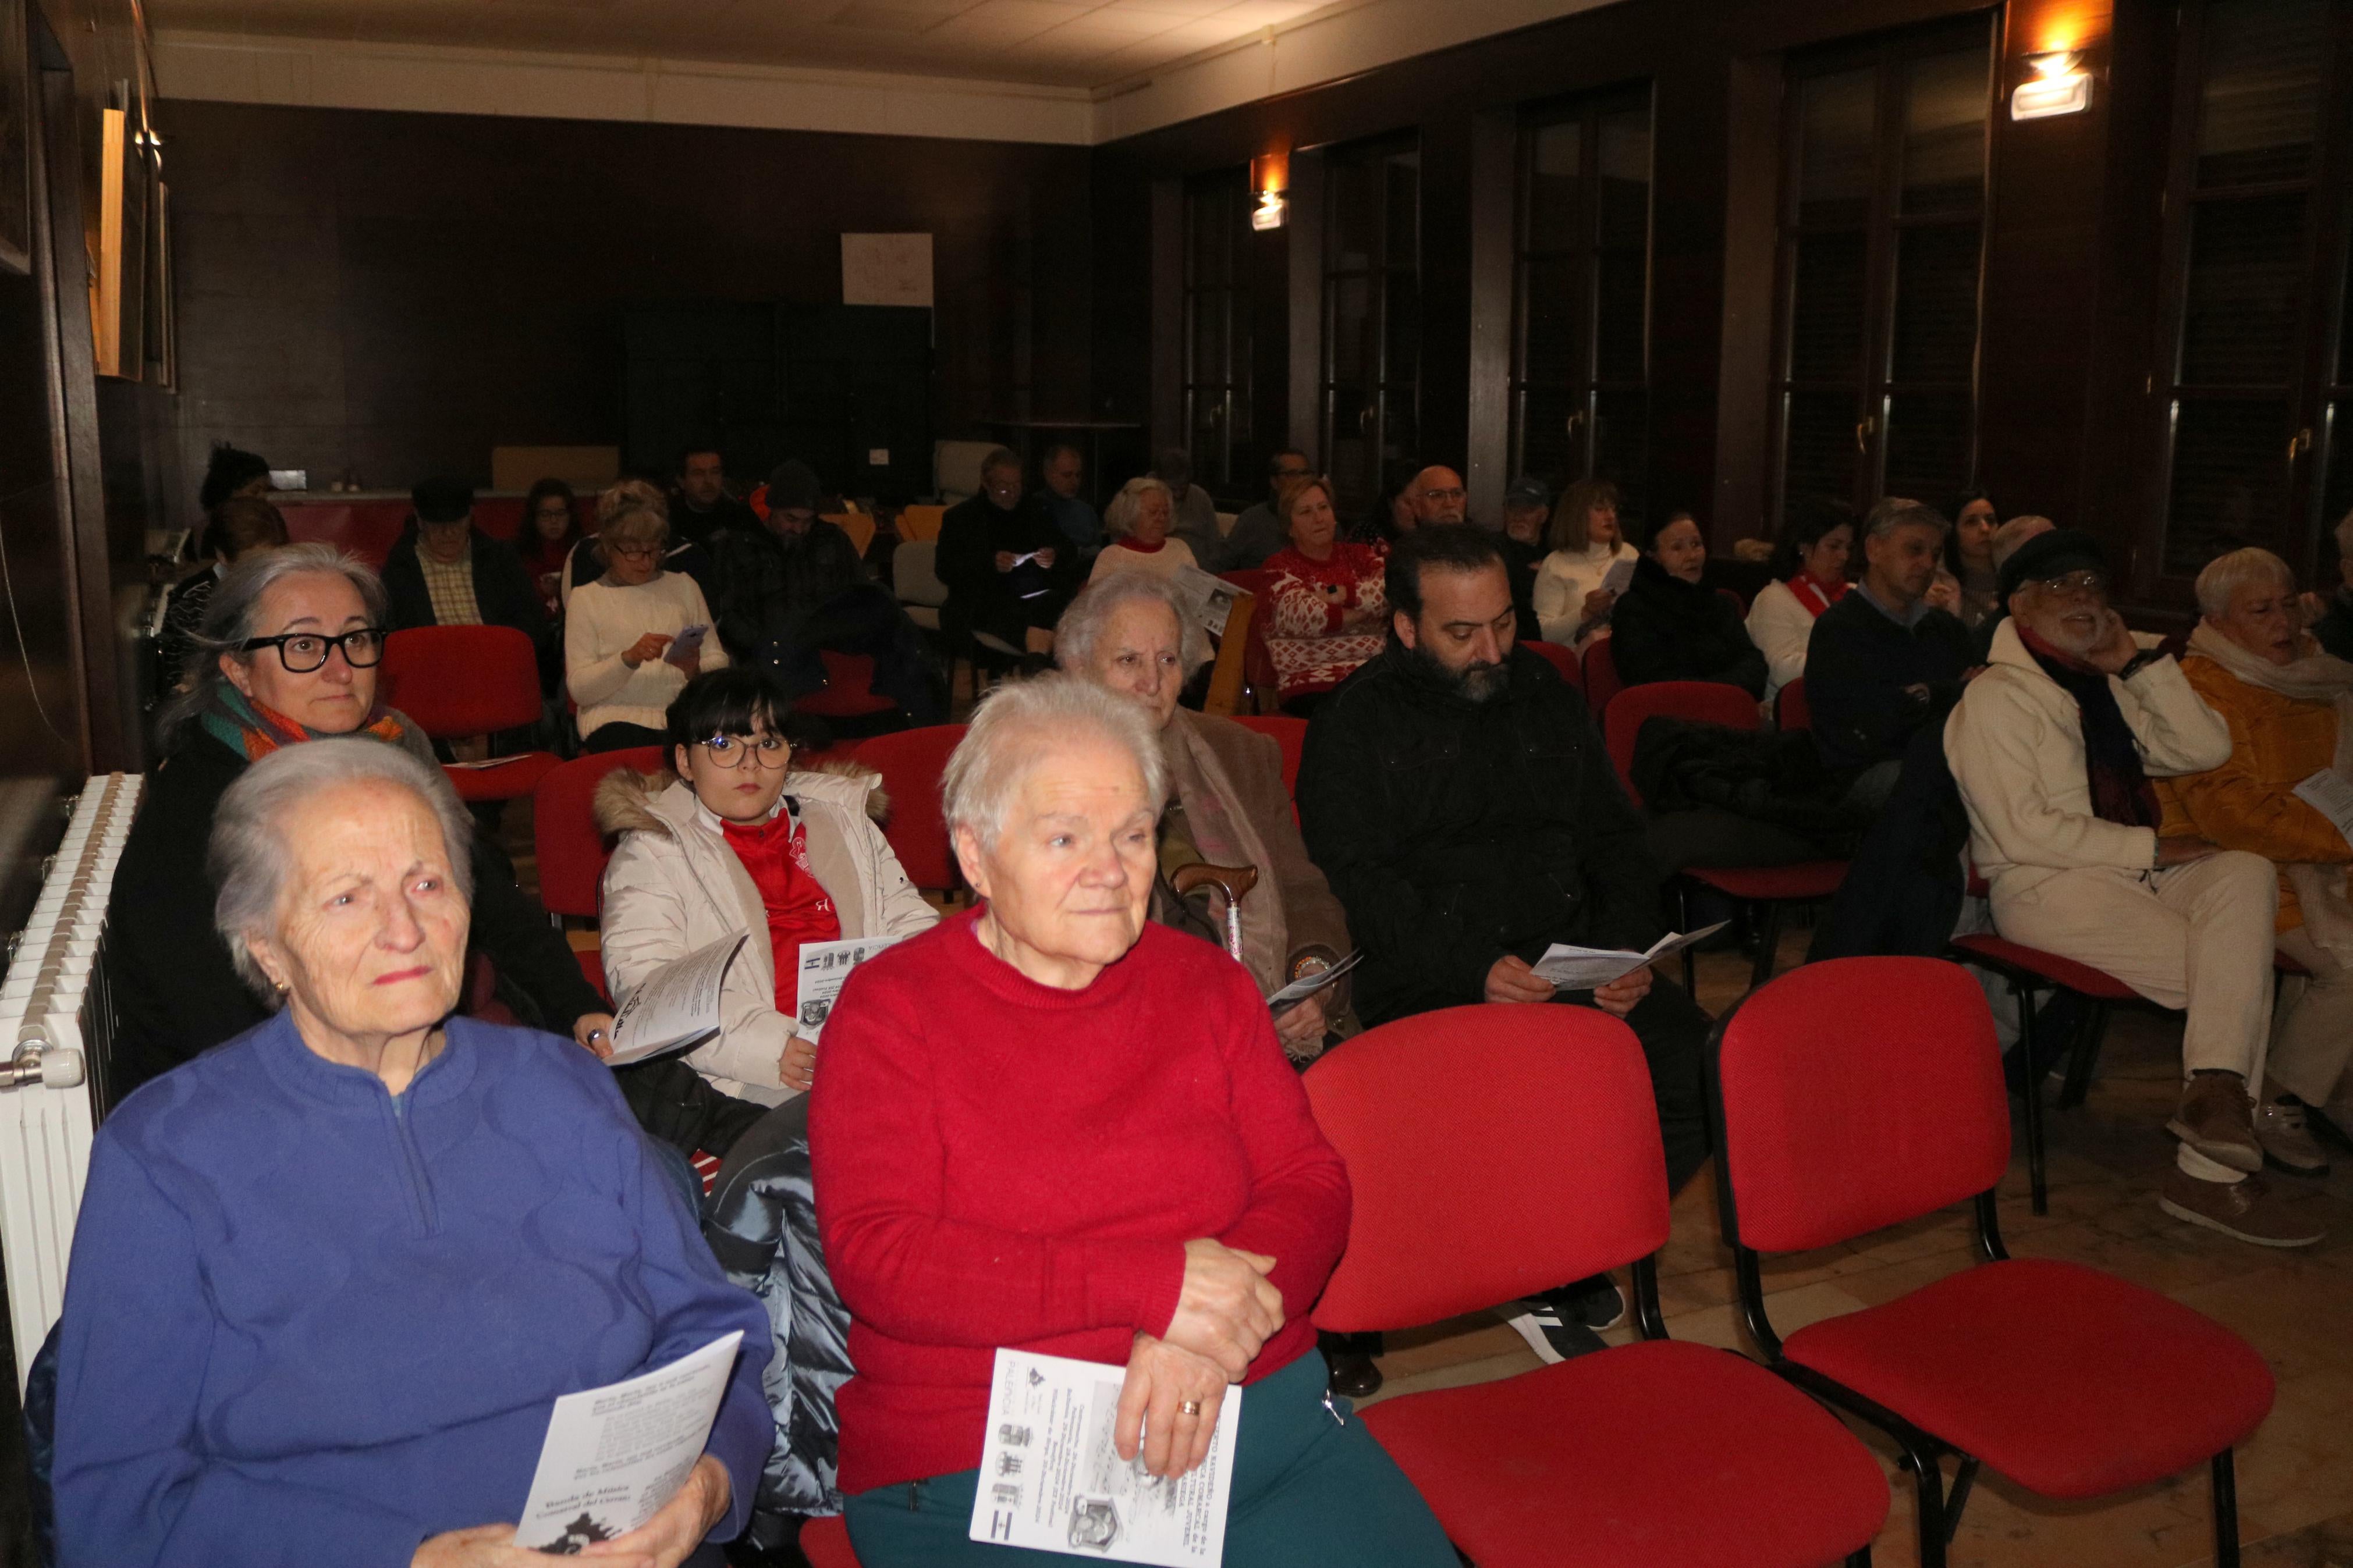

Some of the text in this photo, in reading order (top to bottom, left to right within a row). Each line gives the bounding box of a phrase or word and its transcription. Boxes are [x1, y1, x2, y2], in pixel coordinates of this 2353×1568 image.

[1205, 1455, 1219, 1500] NAVIDEÑO
[545, 1495, 580, 1508] Banda
[583, 1490, 594, 1499] de
[583, 1498, 598, 1508] del
[1193, 1481, 1205, 1531] COMARCAL
[1200, 1509, 1209, 1533] cargo
[1182, 1509, 1193, 1548] JUVENIL
[1191, 1533, 1199, 1544] de
[1200, 1535, 1208, 1546] de
[1191, 1545, 1198, 1553] la
[1199, 1547, 1206, 1556] la
